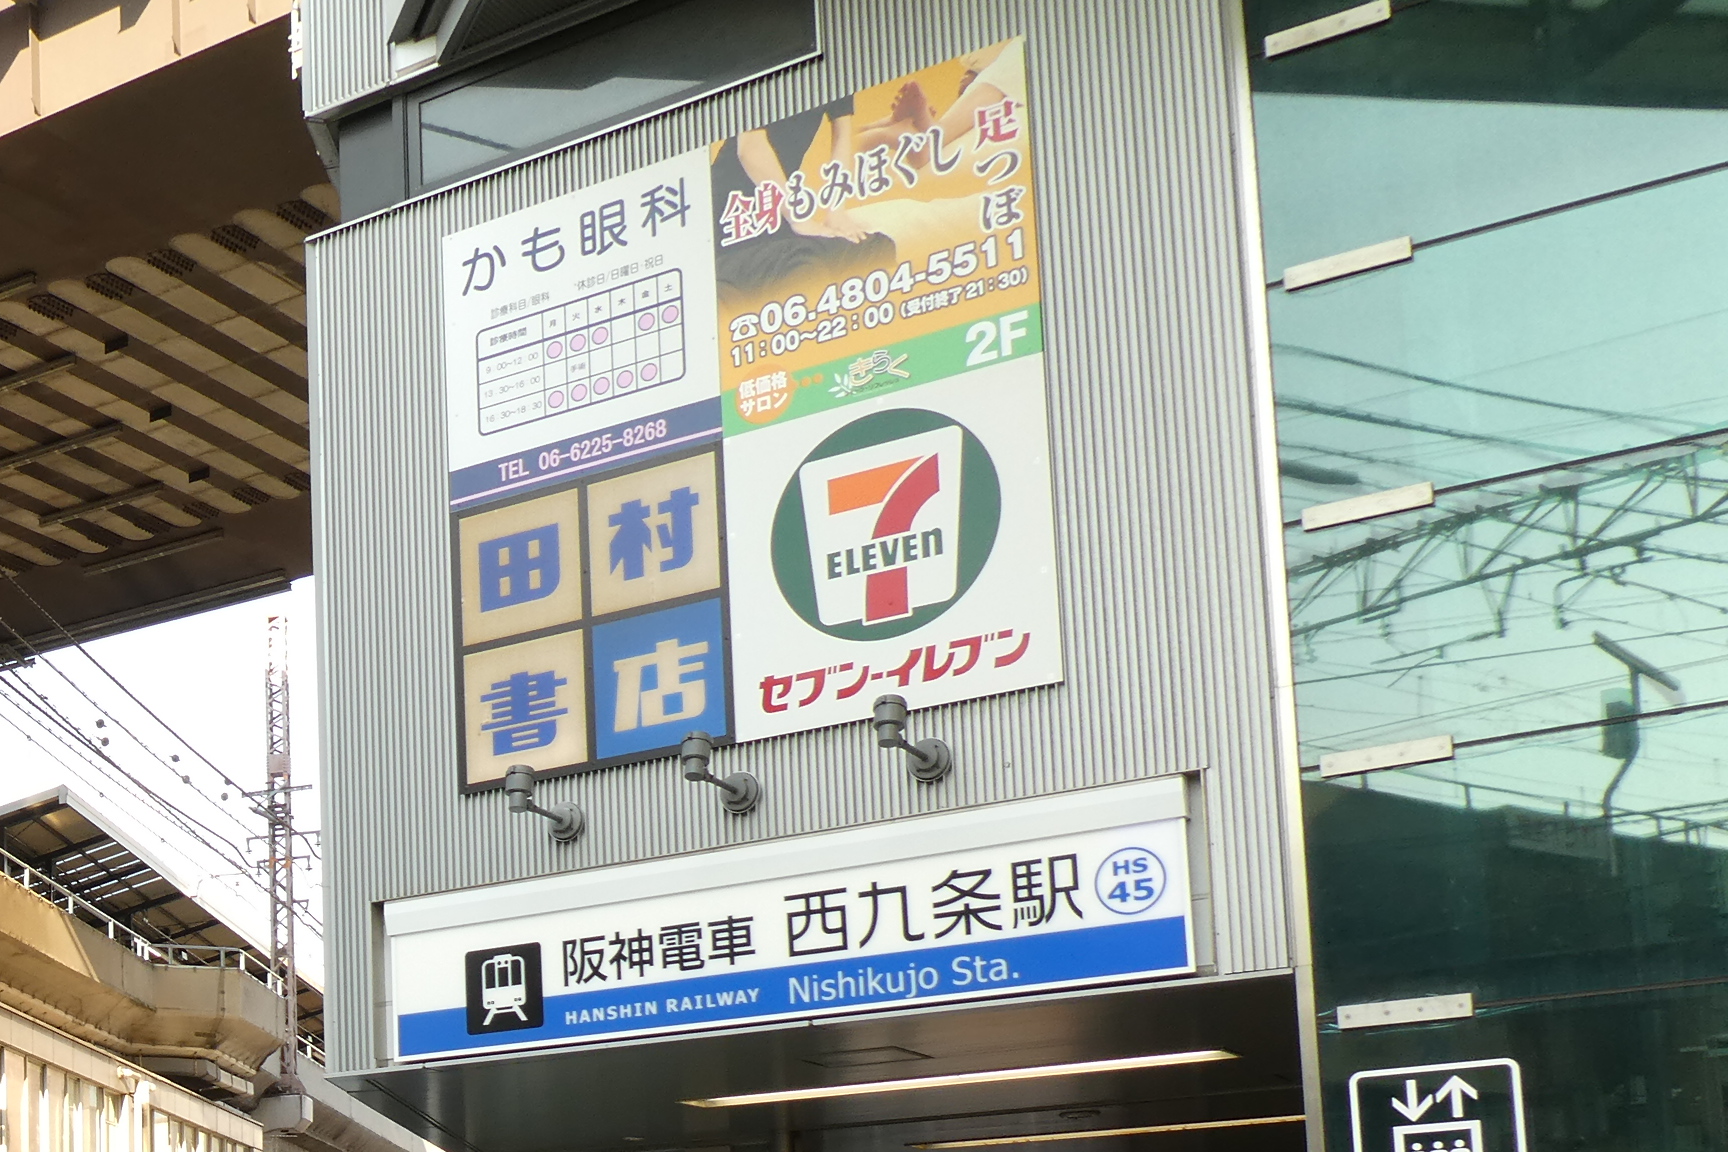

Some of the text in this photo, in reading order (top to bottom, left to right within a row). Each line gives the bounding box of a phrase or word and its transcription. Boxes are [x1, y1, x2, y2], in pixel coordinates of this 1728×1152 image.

[720, 128, 962, 246] 全身もみほぐし
[973, 98, 1024, 232] 足つぼ
[462, 177, 691, 296] かも眼科
[594, 305, 603, 314] 水
[617, 298, 627, 306] 木
[664, 283, 673, 292] 土
[966, 310, 1029, 366] 2F
[739, 371, 789, 399] 低価格
[849, 350, 911, 387] きらく
[740, 392, 789, 416] サロン
[499, 419, 667, 481] TEL 06-6225-8268
[1107, 876, 1157, 905] 45
[1111, 857, 1149, 878] HS
[562, 852, 1085, 988] 阪神電車 西九条駅
[565, 953, 1021, 1026] HANSHIN RAILWAY Nishikujo Sta.
